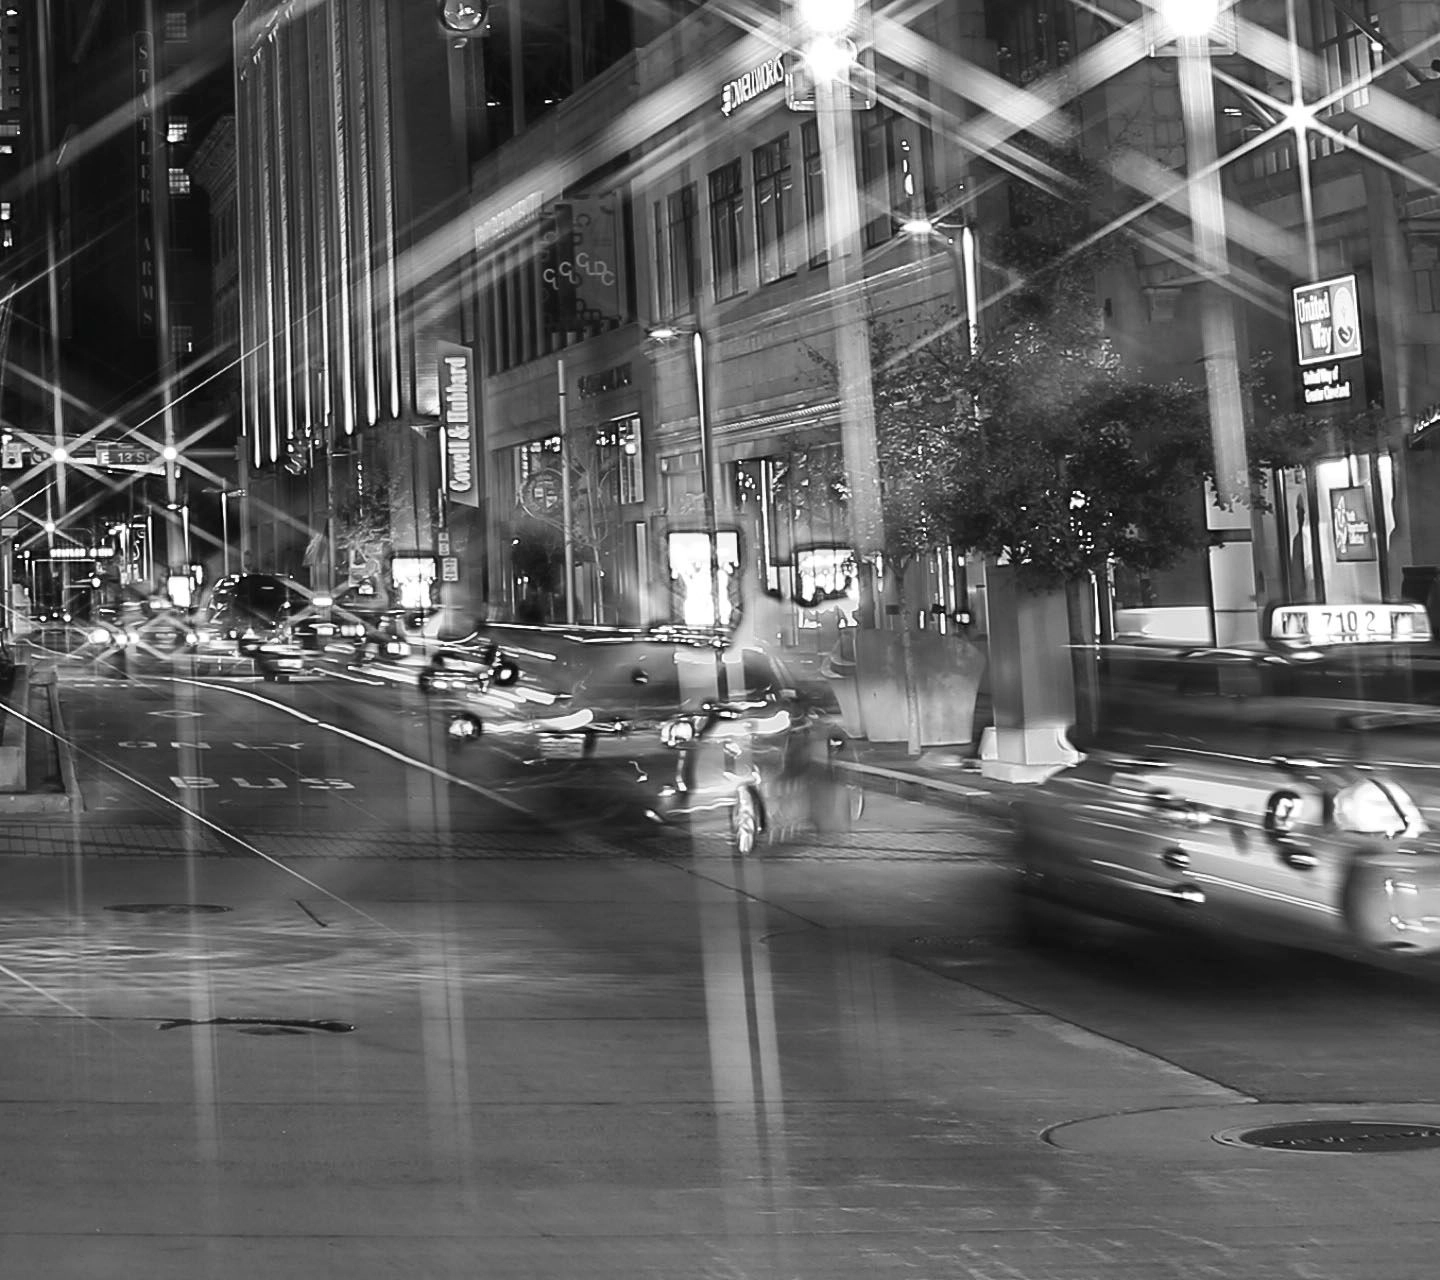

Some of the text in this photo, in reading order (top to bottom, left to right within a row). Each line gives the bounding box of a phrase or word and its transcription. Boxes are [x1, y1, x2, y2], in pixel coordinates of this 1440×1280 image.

[1297, 291, 1331, 324] United
[1310, 322, 1333, 354] Way
[447, 424, 471, 440] &
[117, 741, 305, 751] ONLY
[169, 776, 356, 791] BUS
